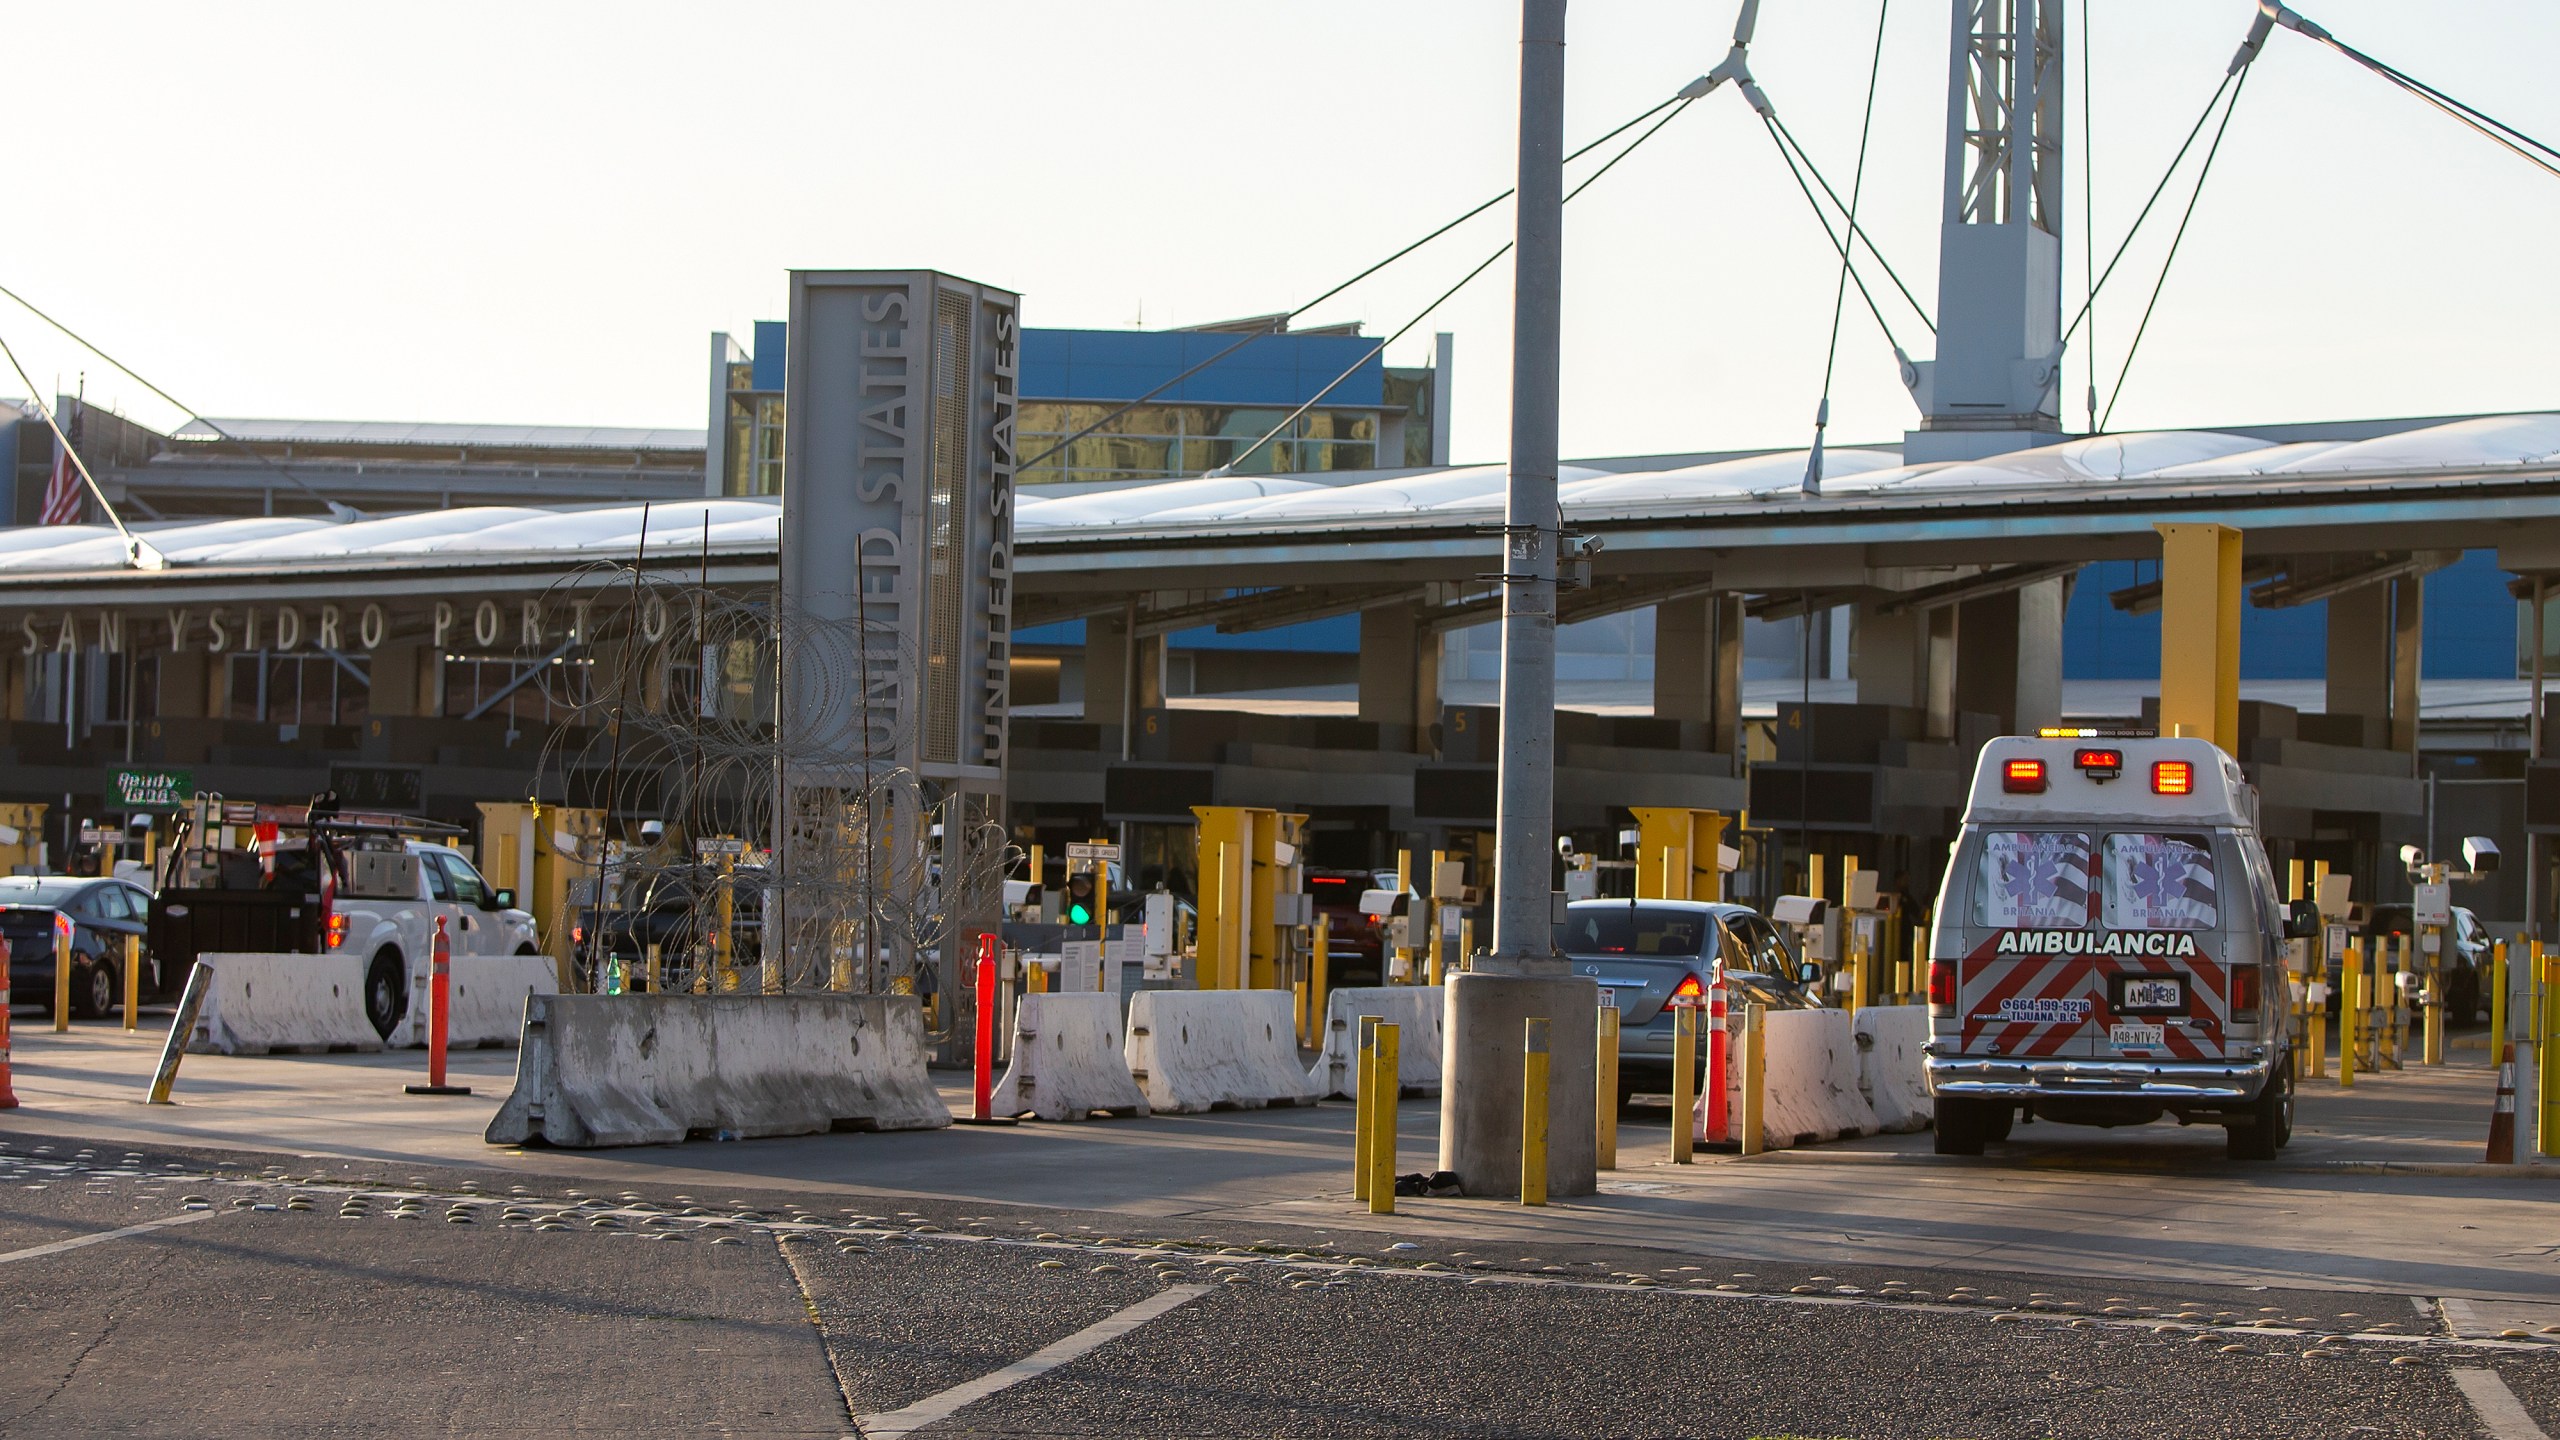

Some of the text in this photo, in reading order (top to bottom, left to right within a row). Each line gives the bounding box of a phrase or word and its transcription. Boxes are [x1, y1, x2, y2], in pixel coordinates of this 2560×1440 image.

[850, 291, 909, 755] UNITED STATES
[983, 312, 1016, 761] UNITED STATES
[22, 611, 120, 655] SAN
[167, 603, 386, 653] YSIDRO
[435, 598, 591, 648] PORT
[371, 720, 382, 737] 9
[1146, 715, 1158, 736] 6
[1455, 712, 1466, 733] 5
[1789, 710, 1802, 730] 4
[2003, 907, 2056, 917] BRITANIA
[2132, 909, 2186, 919] BRITANIA
[1997, 931, 2196, 956] AMBULANCIA
[2012, 1000, 2090, 1012] 664-199-5216
[2059, 1012, 2080, 1022] B.C.
[2113, 1031, 2161, 1044] A48-NTV-2
